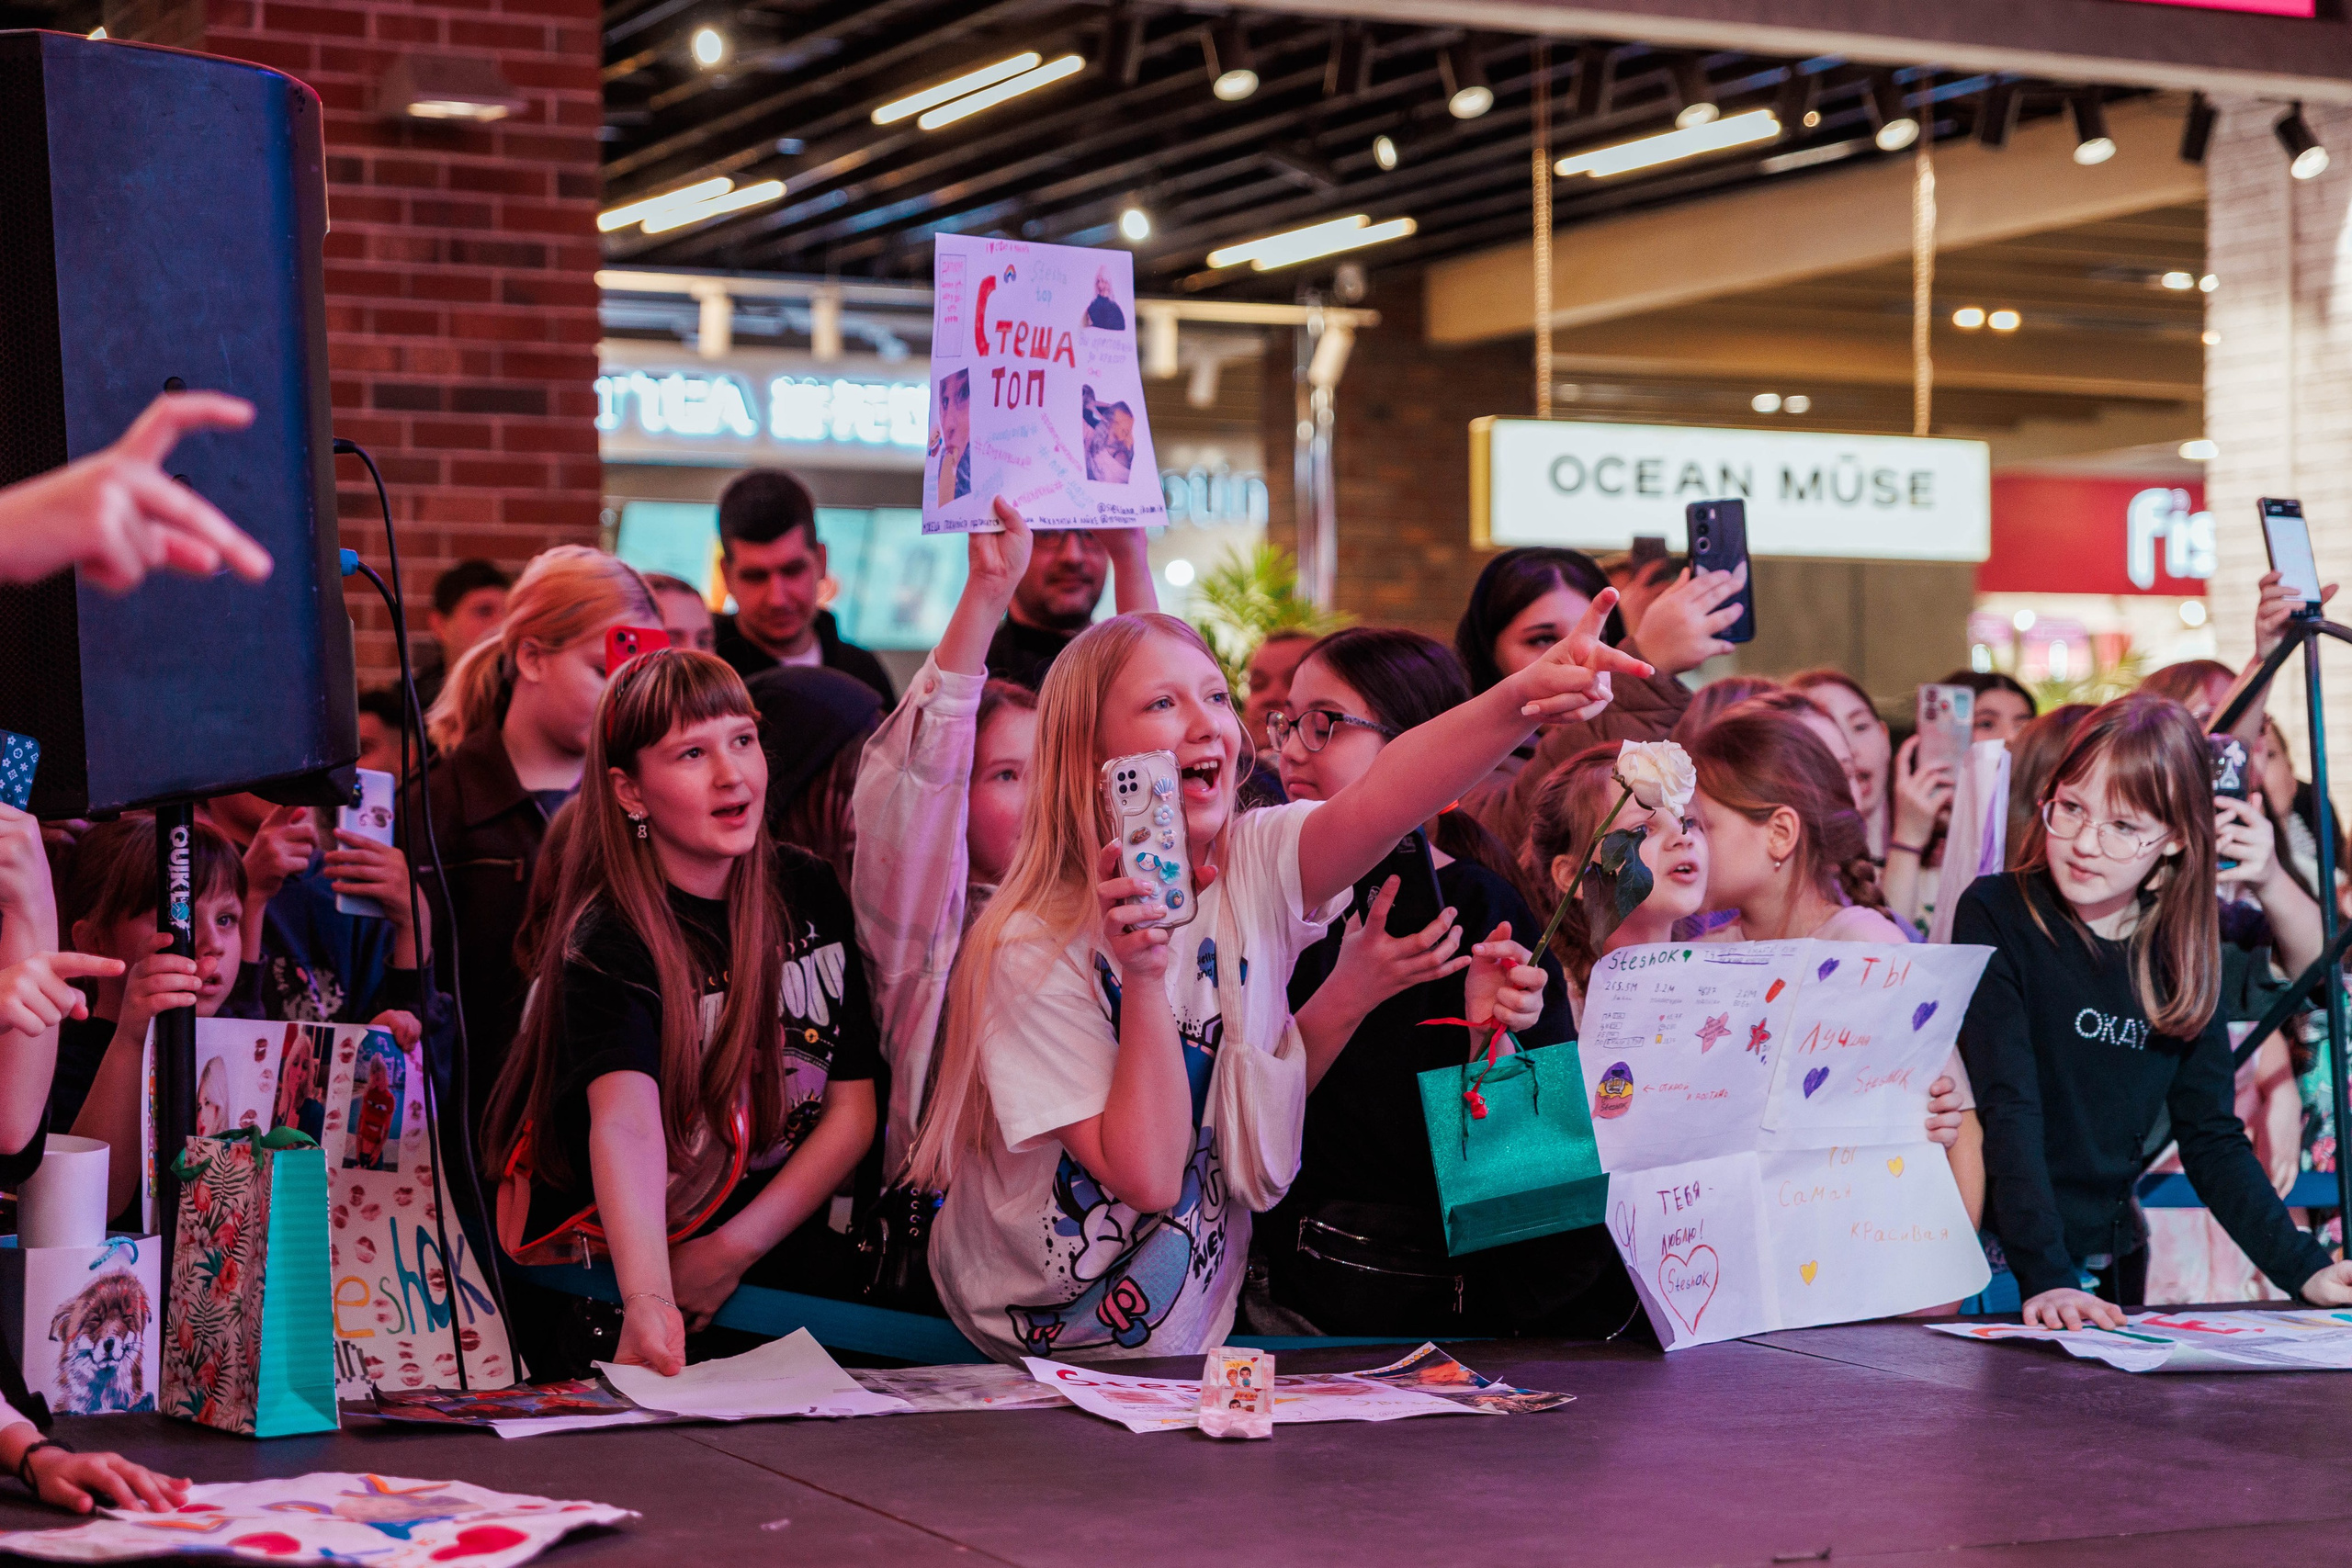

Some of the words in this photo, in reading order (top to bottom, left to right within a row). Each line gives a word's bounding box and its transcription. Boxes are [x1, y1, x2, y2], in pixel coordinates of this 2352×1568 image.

[991, 367, 1046, 410] ТОП
[1548, 454, 1753, 498] OCEAN
[1779, 453, 1935, 509] MŪSE
[2075, 1008, 2153, 1050] OKAY
